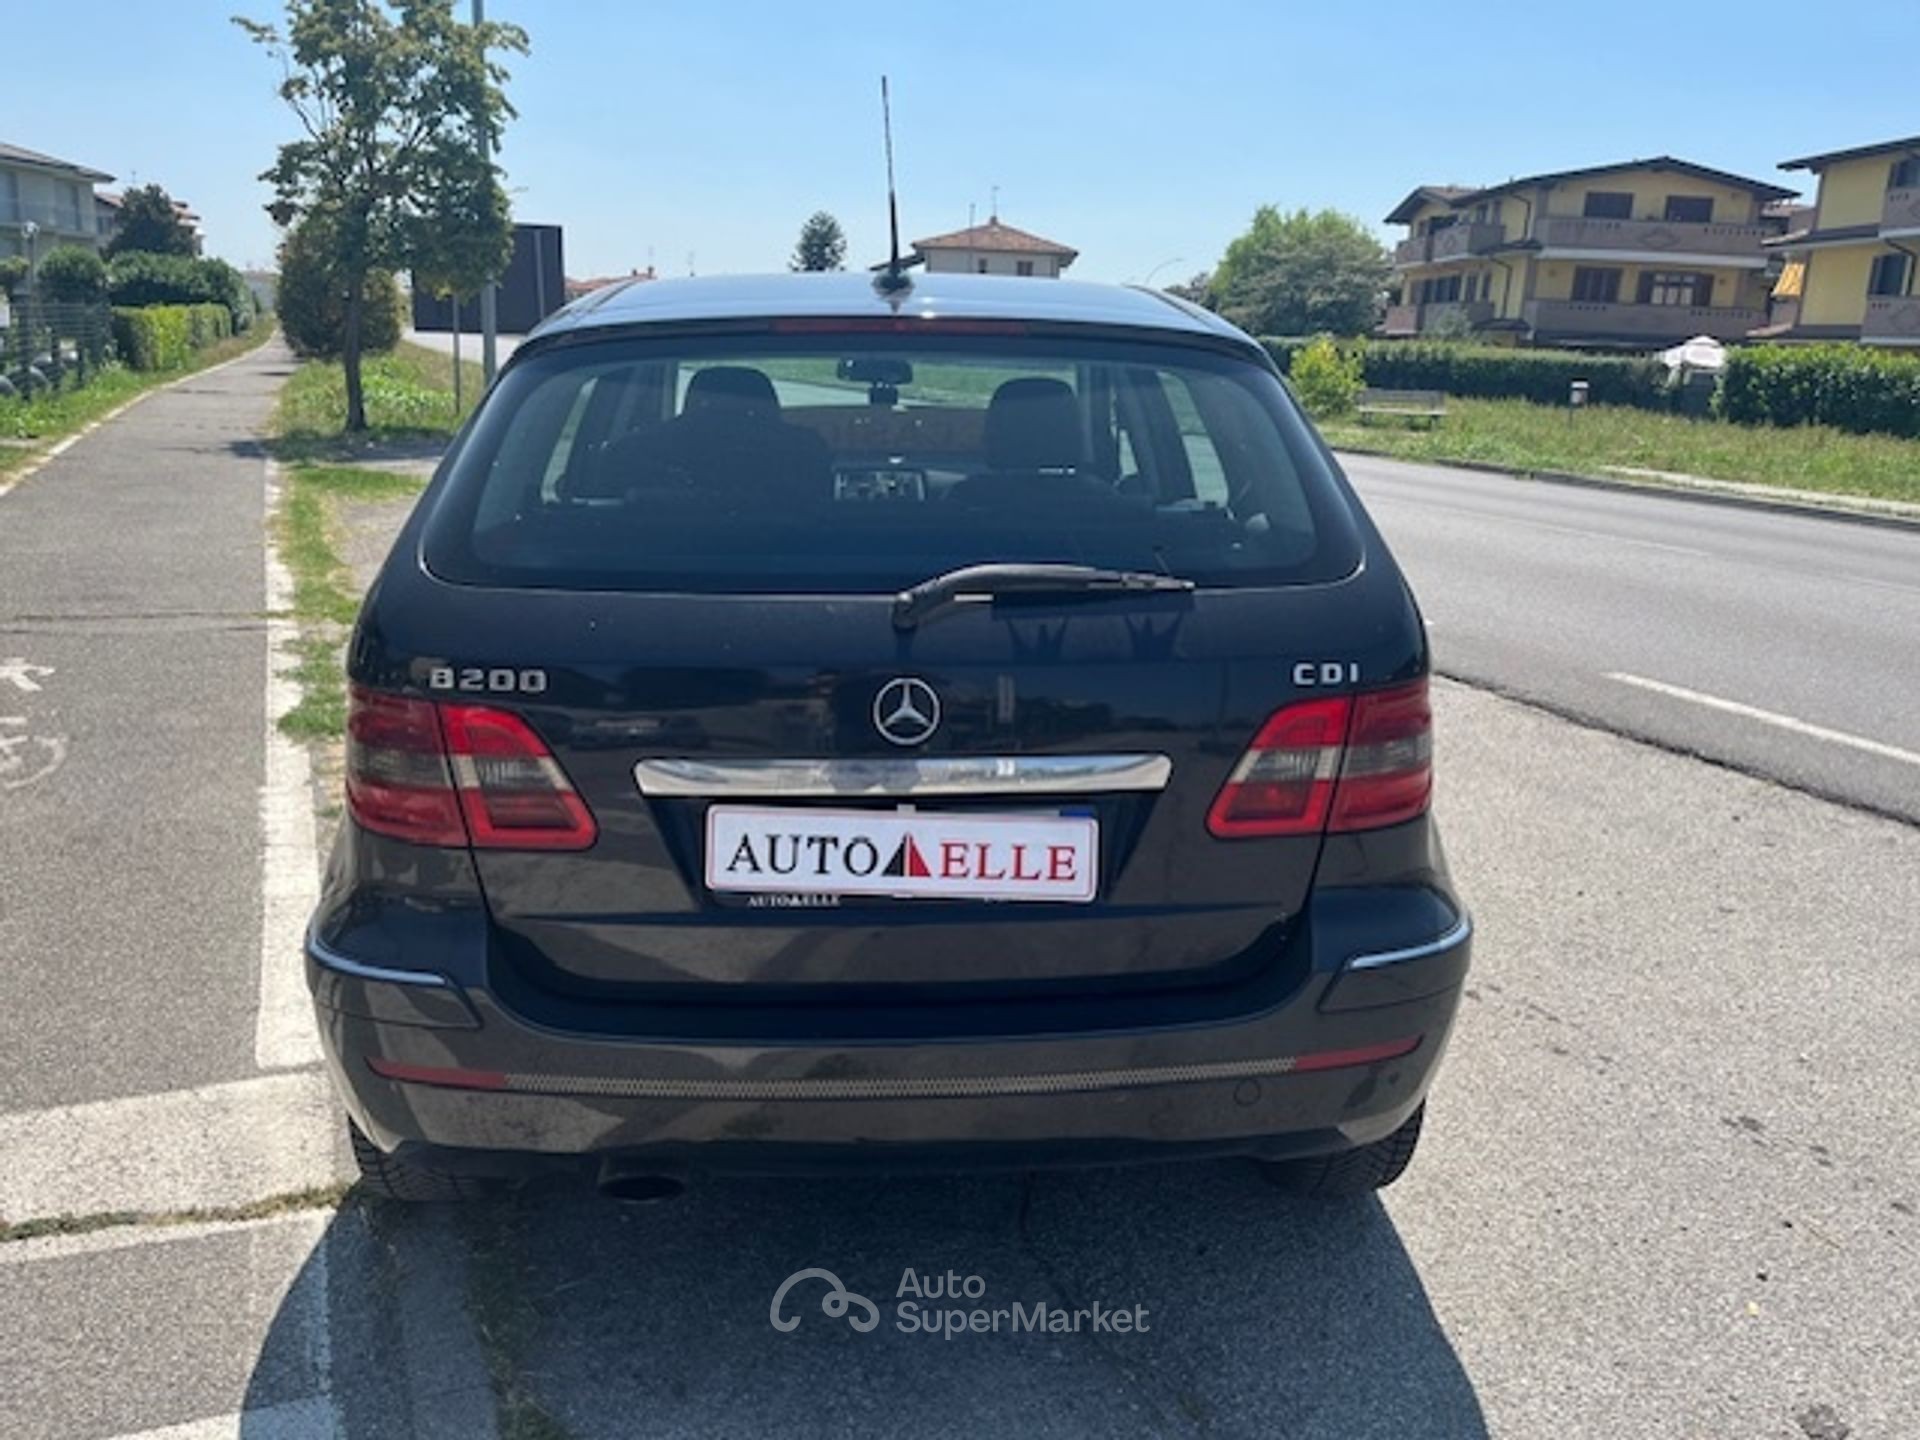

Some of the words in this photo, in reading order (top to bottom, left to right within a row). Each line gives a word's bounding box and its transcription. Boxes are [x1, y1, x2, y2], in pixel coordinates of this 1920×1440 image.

[430, 668, 547, 692] B200
[1293, 663, 1358, 685] CDI
[939, 843, 1078, 880] ELLE
